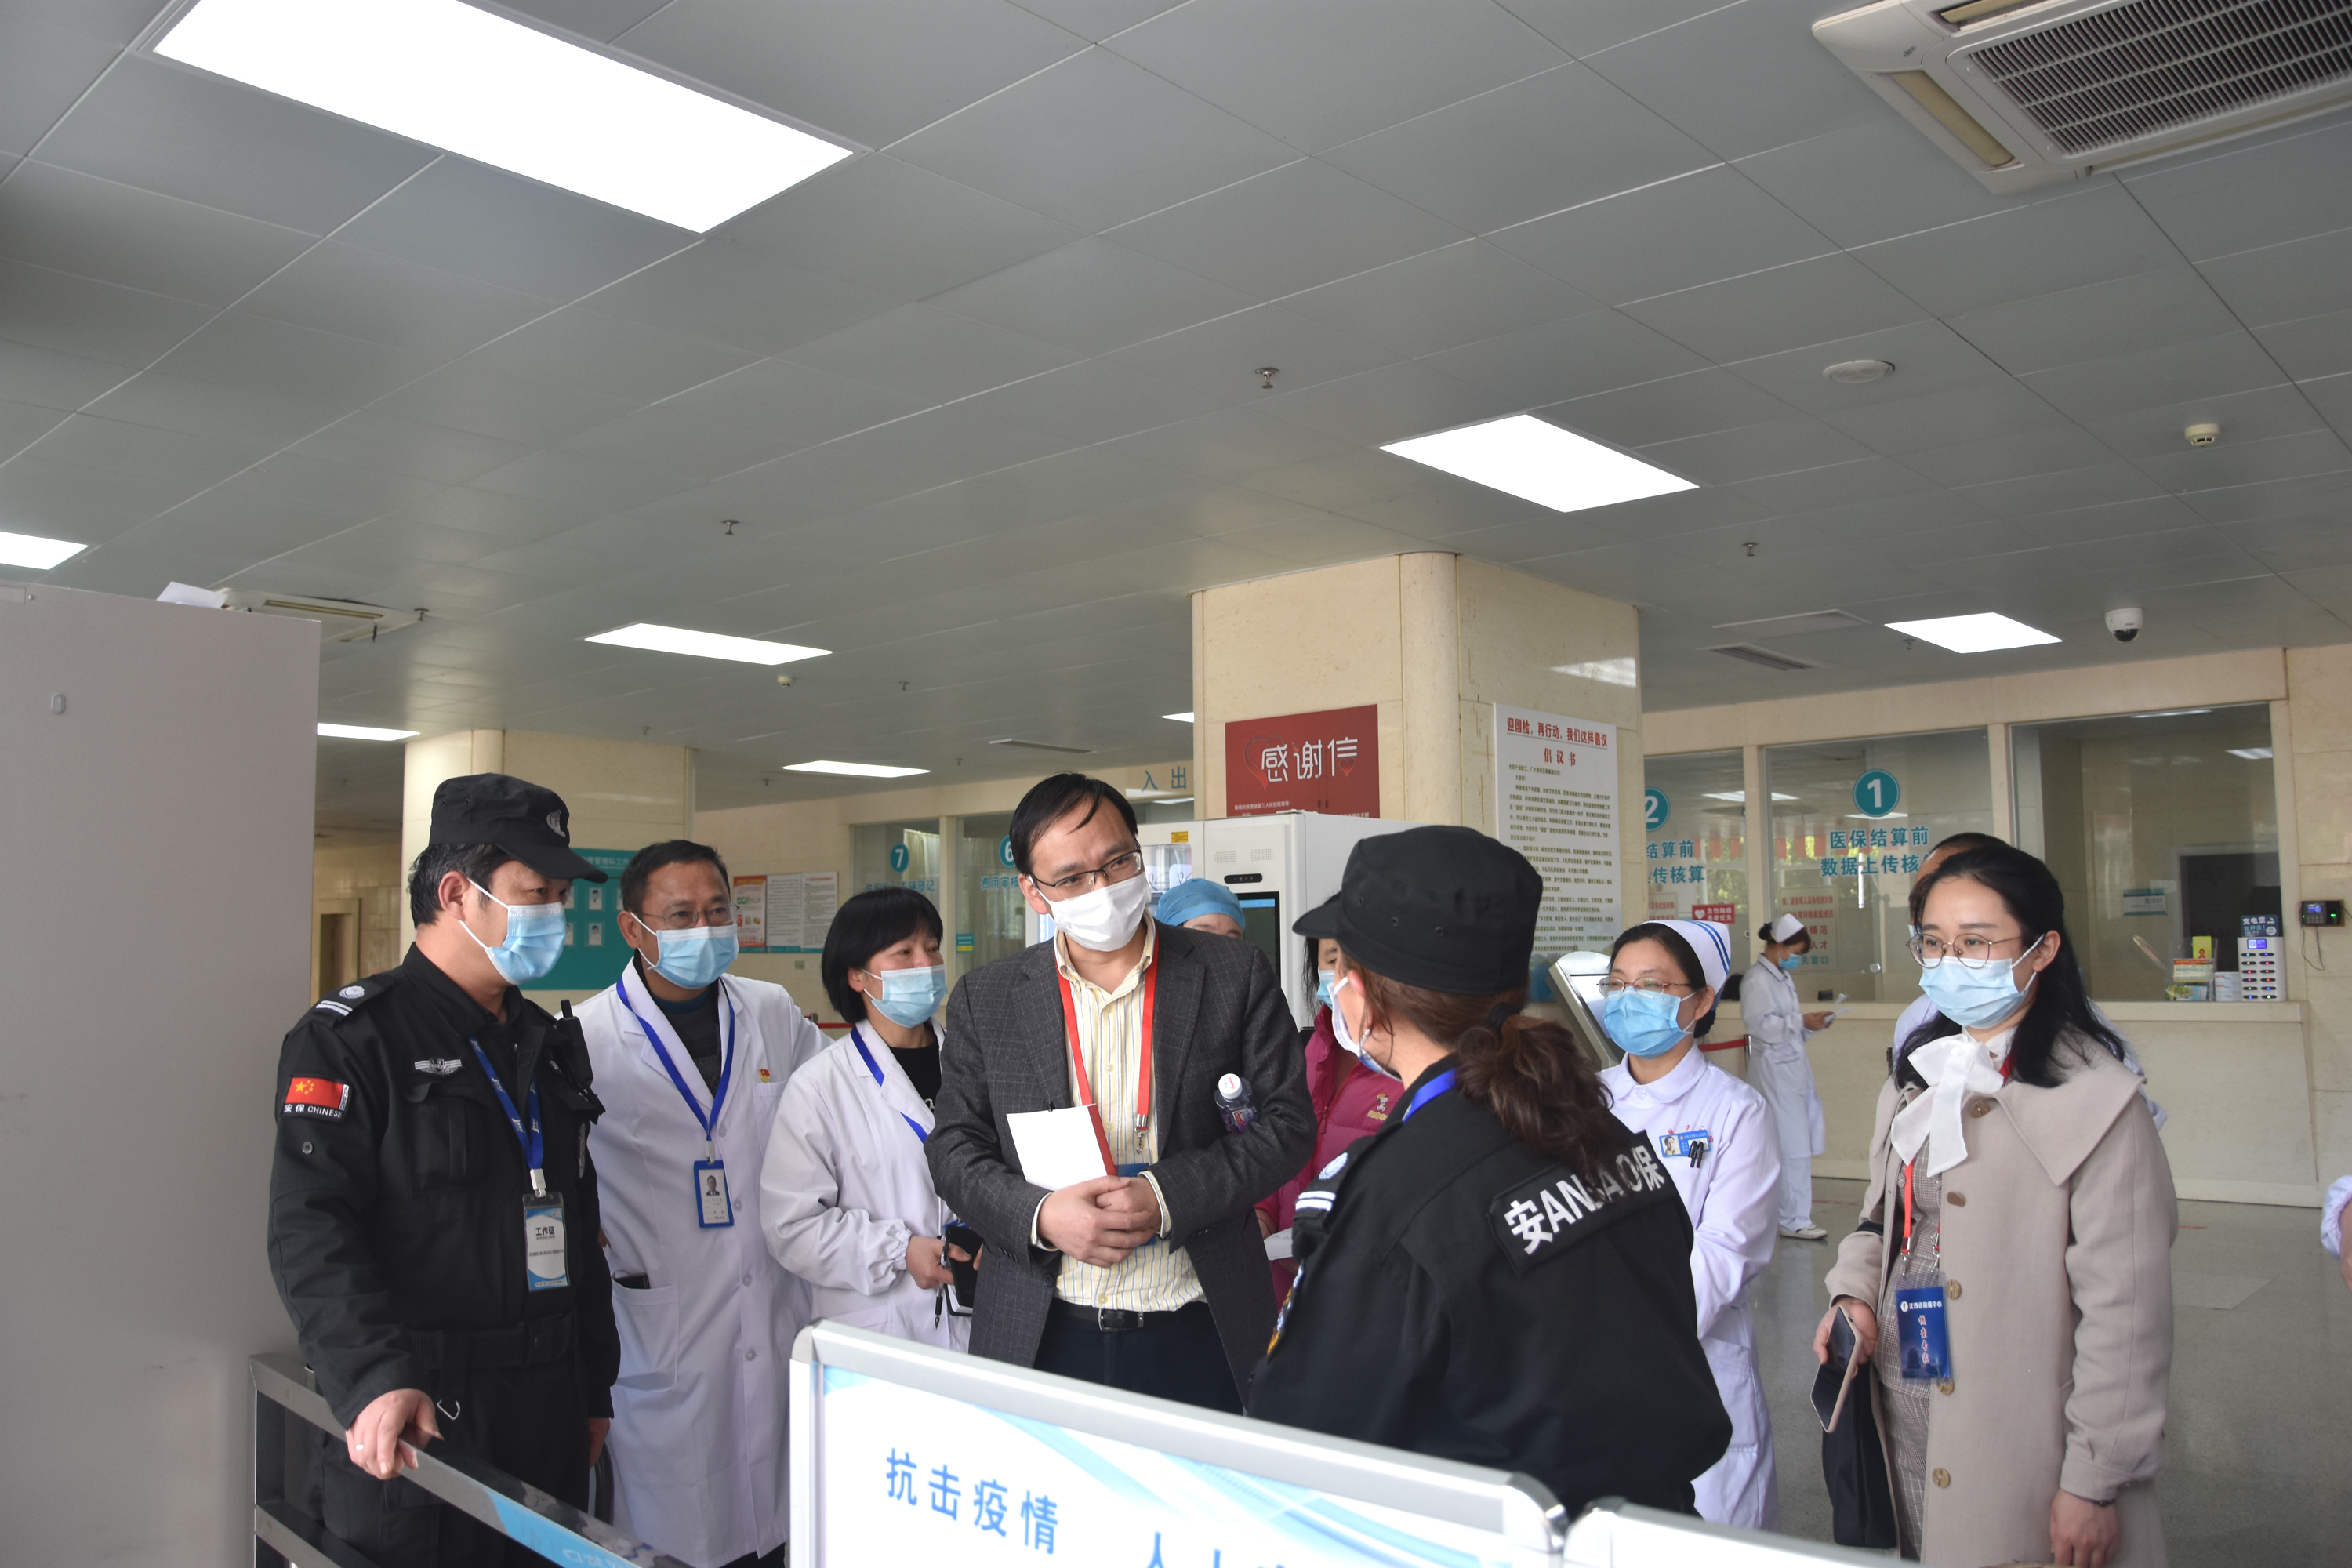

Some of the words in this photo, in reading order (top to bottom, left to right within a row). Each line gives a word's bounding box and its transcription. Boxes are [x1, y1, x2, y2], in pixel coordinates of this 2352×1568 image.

[1261, 736, 1359, 782] 感谢信
[1544, 747, 1576, 766] 倡议书
[1867, 779, 1882, 808] 1
[1645, 795, 1659, 823] 2
[1830, 826, 1929, 849] 医保结算前
[895, 849, 904, 868] 7
[1004, 842, 1013, 862] 6
[1820, 852, 1929, 877] 数据上传核
[982, 876, 1019, 889] 费用审核
[1647, 866, 1704, 884] 传核算
[284, 1103, 305, 1113] 安保
[307, 1105, 343, 1118] CHINESE
[535, 1226, 555, 1236] 工作证
[886, 1447, 1059, 1555] 抗击疫情
